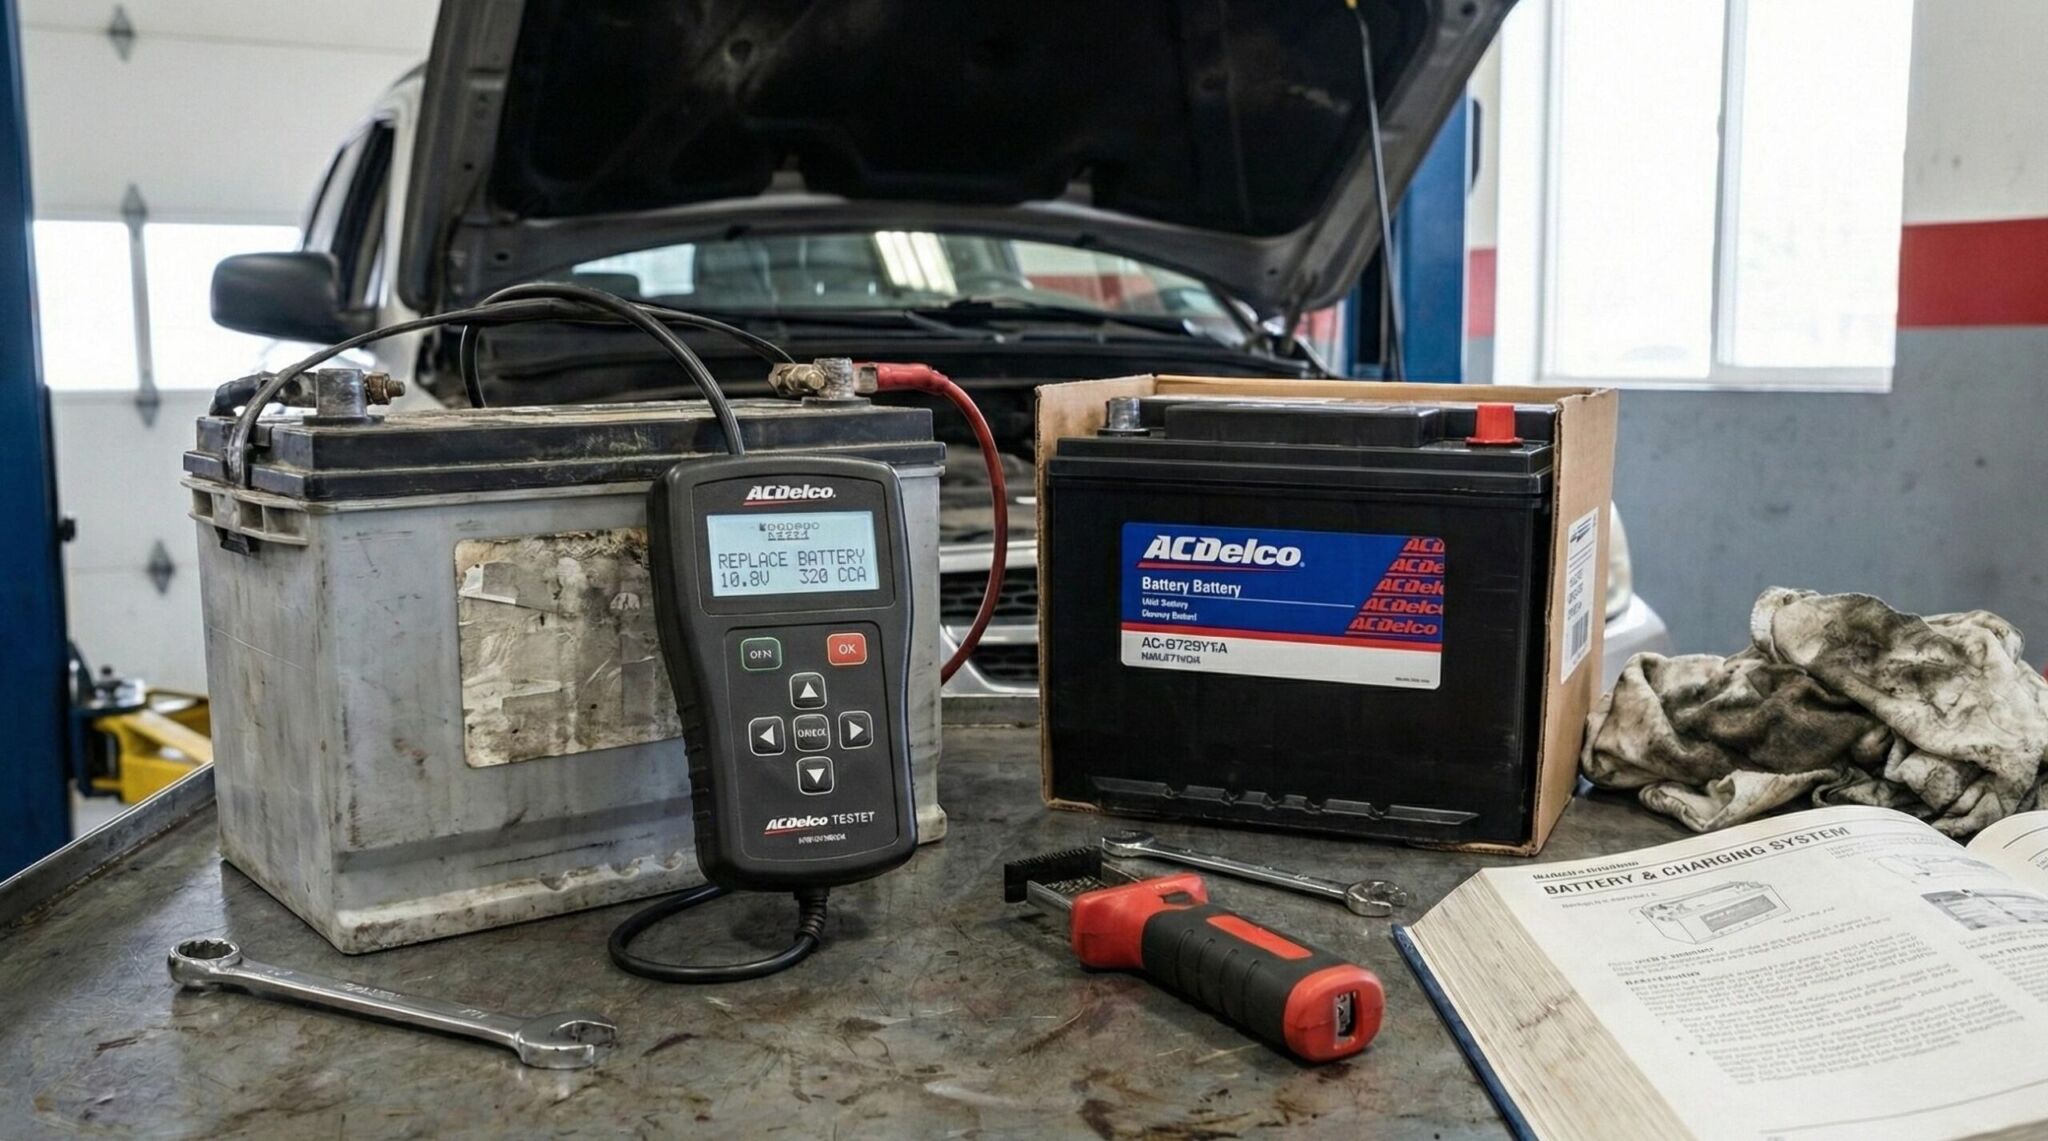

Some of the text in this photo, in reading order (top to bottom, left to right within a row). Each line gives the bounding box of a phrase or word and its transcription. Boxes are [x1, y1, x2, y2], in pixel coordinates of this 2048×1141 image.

[746, 484, 834, 500] ACDelco
[718, 548, 866, 569] REPLACE BATTERY
[1142, 535, 1302, 567] ACDelco
[721, 566, 867, 588] 10.8V 320 CCA
[1142, 576, 1242, 598] Battery Battery
[1348, 616, 1438, 635] ACDelco
[838, 643, 857, 655] OK
[765, 811, 875, 830] ACDelco TESTET
[1543, 874, 1634, 896] BATTERY
[1641, 871, 1658, 880] &
[1662, 845, 1767, 877] CHARGING
[1769, 826, 1851, 851] SYSTEM
